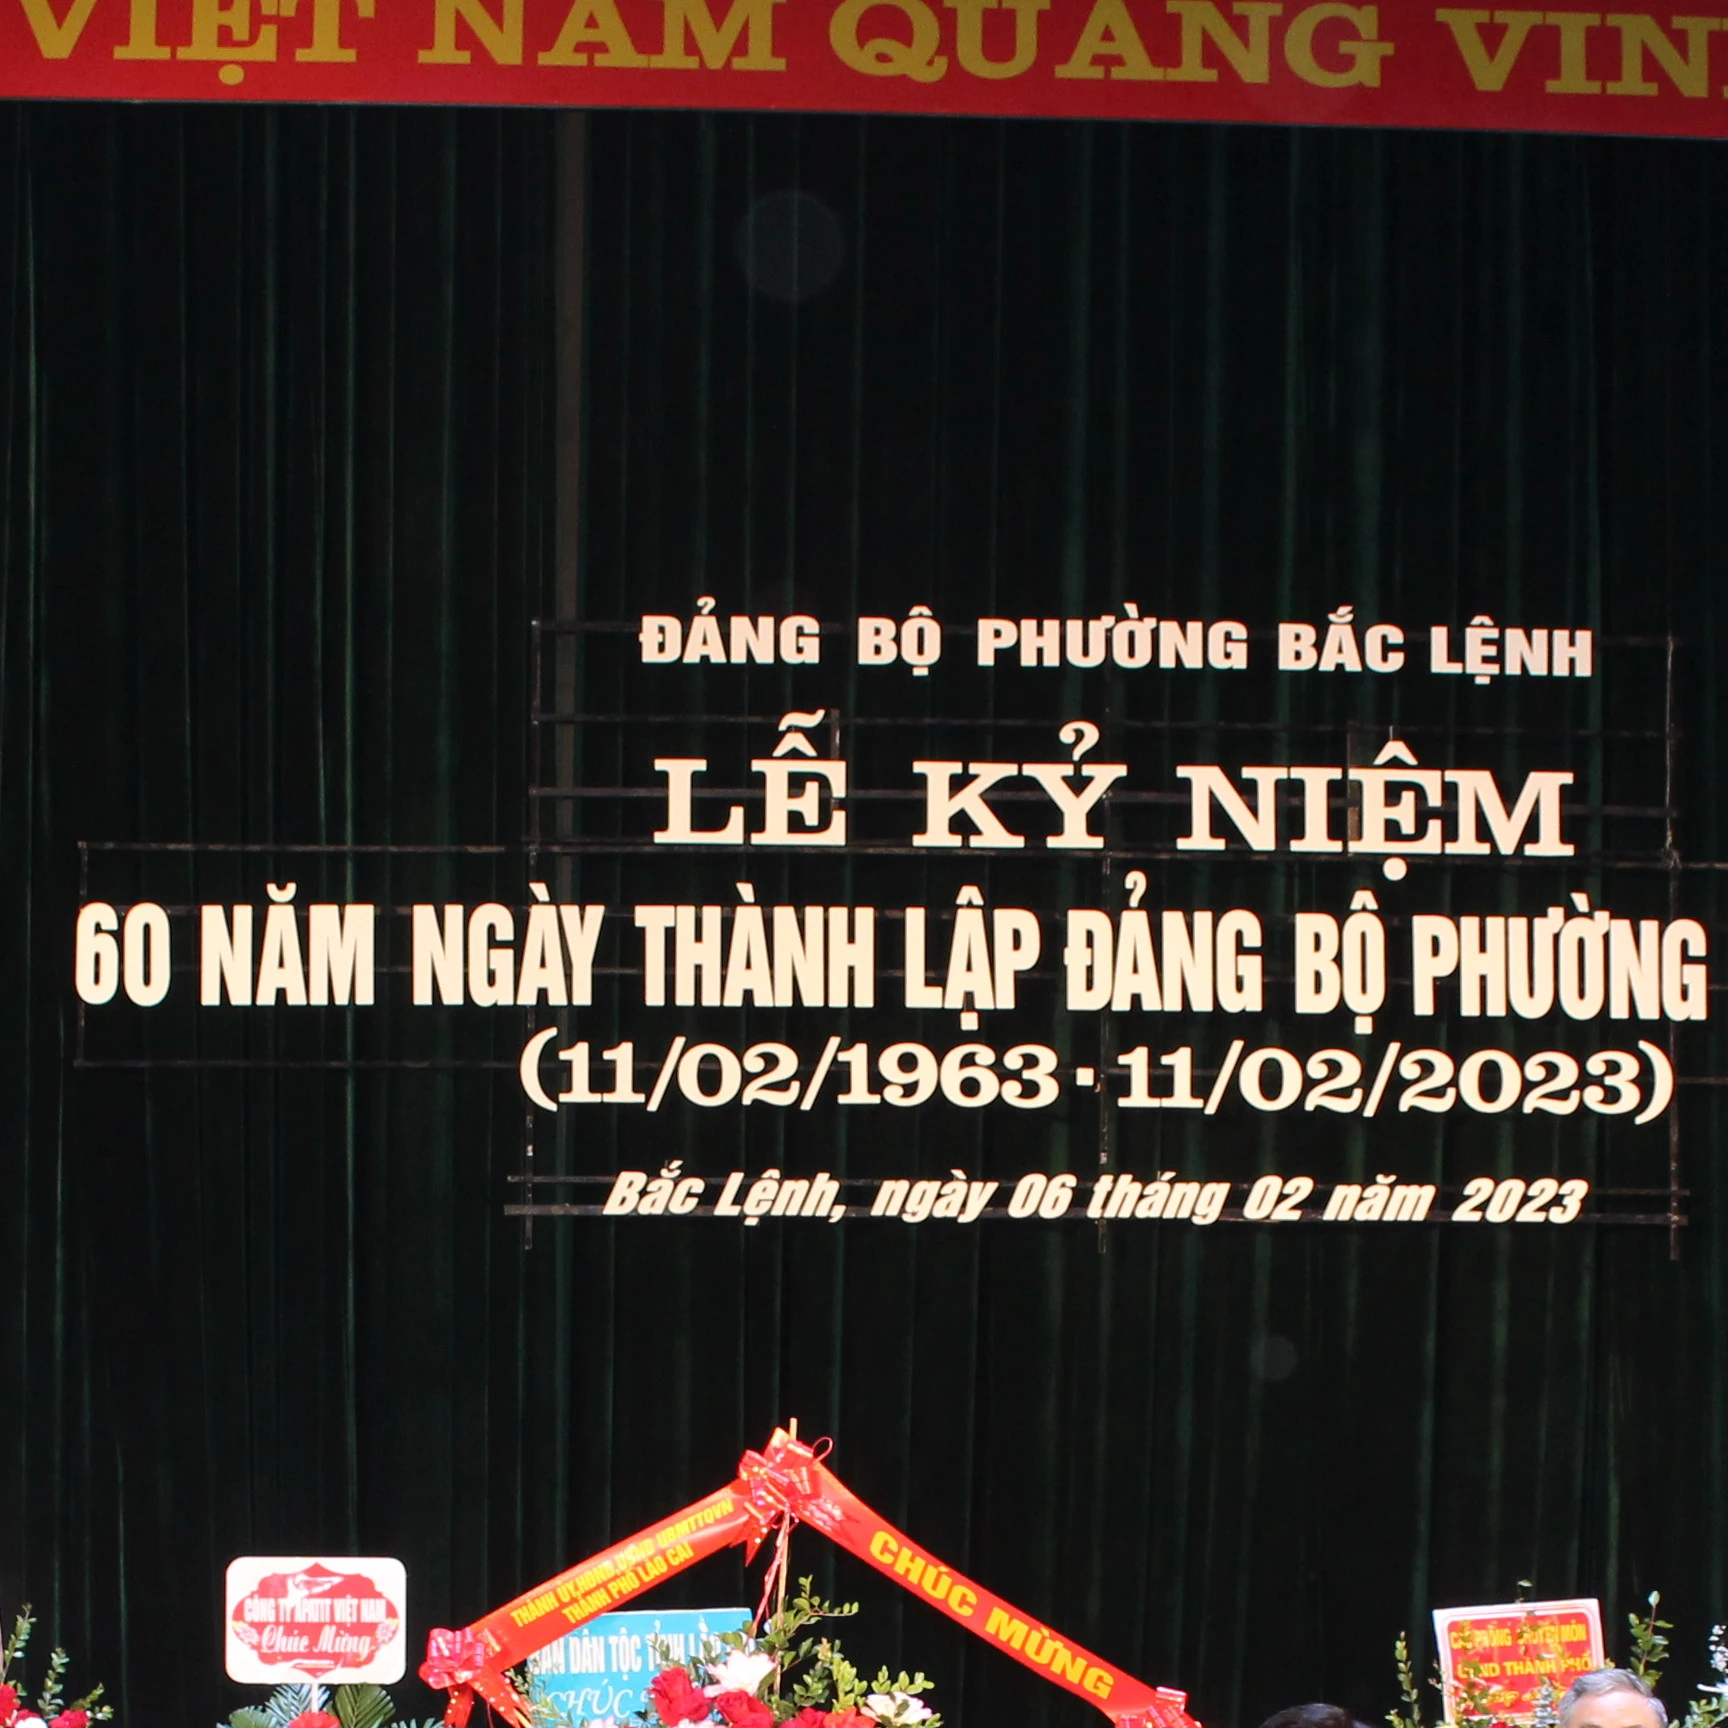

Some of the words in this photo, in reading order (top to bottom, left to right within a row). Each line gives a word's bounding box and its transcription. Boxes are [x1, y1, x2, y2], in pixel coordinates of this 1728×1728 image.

[417, 0, 788, 72] NAM
[829, 0, 1394, 89] QUANG
[639, 598, 819, 663] ĐẢNG
[858, 607, 940, 676] BỘ
[978, 603, 1247, 669] PHƯỜNG
[1279, 604, 1404, 673] BẮC
[1431, 616, 1592, 684] LỆNH
[654, 710, 845, 846] LỄ
[913, 722, 1127, 848] KỶ
[1176, 741, 1575, 880] NIỆM
[76, 903, 170, 1006] 60
[202, 884, 374, 1006] NĂM
[414, 883, 605, 1007] NGÀY
[635, 883, 874, 1007] THÀNH
[905, 886, 1041, 1030] LẬP
[1061, 872, 1262, 1013] ĐẢNG
[1295, 891, 1385, 1034] BỘ
[1412, 893, 1706, 1022] PHƯỜNG
[1117, 1031, 1673, 1125] 11/02/2023)
[602, 1160, 704, 1216] Bắc
[713, 1169, 846, 1226] Lệnh,
[870, 1170, 998, 1223] ngày
[1008, 1173, 1077, 1219] 06
[1086, 1171, 1230, 1225] tháng
[1243, 1175, 1313, 1220] 02
[1322, 1175, 1435, 1222] năm
[1451, 1177, 1589, 1223] 2023
[243, 1595, 276, 1622] CÔNG
[333, 1594, 358, 1627] VIỆT
[360, 1598, 386, 1623] NAM
[510, 1592, 559, 1627] THÀNH
[562, 1588, 612, 1624] THÀNH
[608, 1567, 640, 1600] PHỐ
[666, 1542, 696, 1567] CAI
[869, 1530, 978, 1617] CHÚC
[984, 1607, 1115, 1700] MỪNG
[261, 1624, 309, 1654] Chúc
[312, 1625, 376, 1661] Mừng
[570, 1628, 605, 1674] DÂN
[608, 1627, 643, 1681] TỘC
[1503, 1653, 1557, 1677] THÀNH
[1560, 1619, 1587, 1642] MÔN
